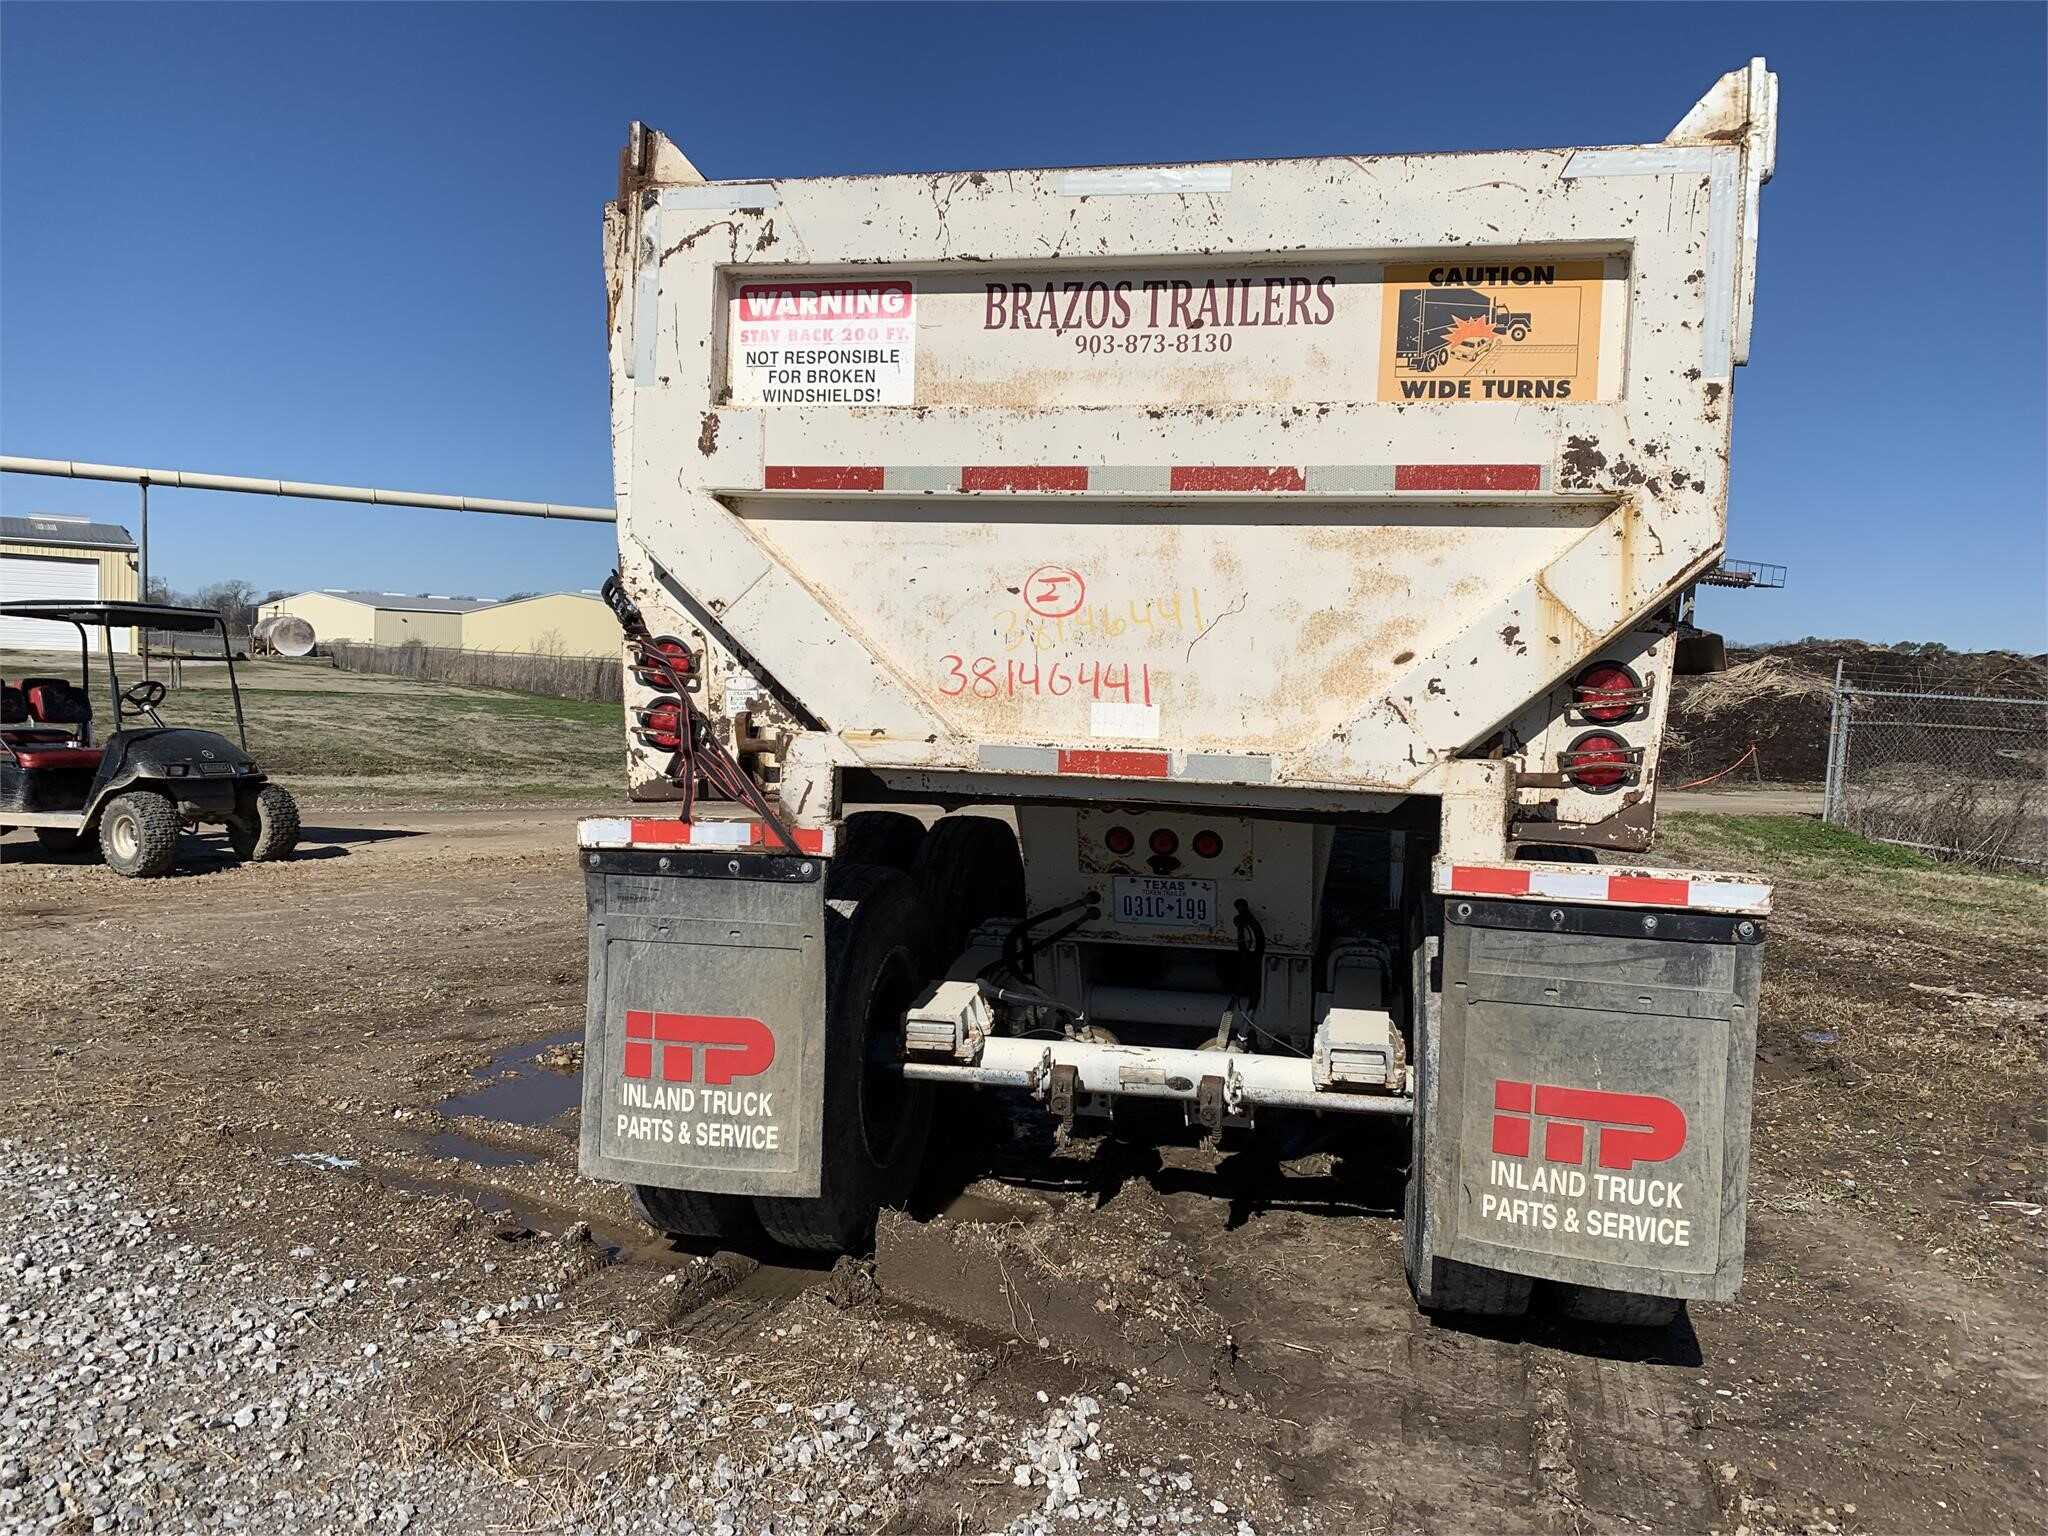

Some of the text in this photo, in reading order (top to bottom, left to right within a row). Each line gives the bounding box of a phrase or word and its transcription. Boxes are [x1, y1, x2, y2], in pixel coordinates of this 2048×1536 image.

[1428, 265, 1555, 287] CAUTION
[747, 288, 904, 317] WARNING
[984, 276, 1336, 330] BRAZOS TRAILERS
[740, 328, 779, 343] STAY
[789, 328, 833, 342] BACK
[842, 327, 879, 341] 200
[1075, 333, 1233, 354] 903-873-8130
[746, 350, 900, 367] NOT RESPONSIBLE
[768, 369, 876, 384] FOR BROKEN
[763, 389, 881, 403] WINDSHIELDS!
[1400, 380, 1572, 399] WIDE TURNS
[939, 655, 1153, 707] 38146441
[1144, 879, 1185, 890] TEXAS
[623, 1083, 773, 1117] INLAND TRUCK
[617, 1114, 779, 1149] PARTS & SERVICE
[1491, 1160, 1683, 1209] INLAND TRUCK
[1482, 1194, 1691, 1246] PARTS & SERVICE
